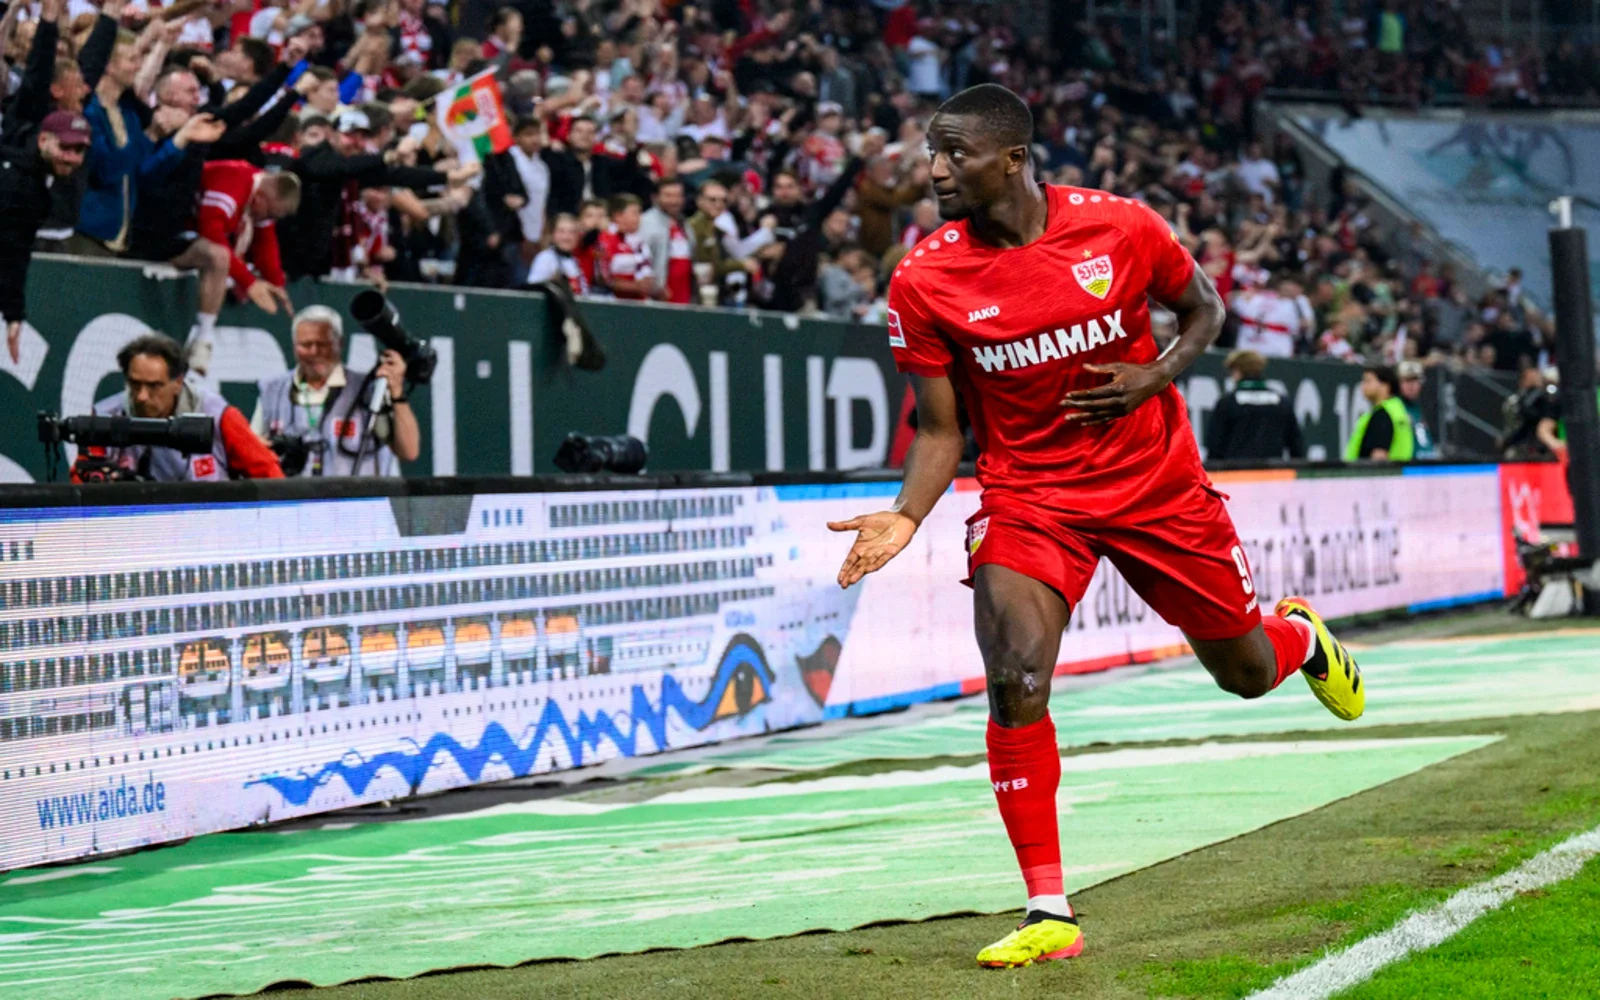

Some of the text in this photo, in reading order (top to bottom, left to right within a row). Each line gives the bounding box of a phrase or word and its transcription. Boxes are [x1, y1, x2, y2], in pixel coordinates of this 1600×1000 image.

[967, 305, 1000, 323] JAKO
[971, 309, 1128, 373] WINAMAX
[1230, 545, 1253, 595] 9
[36, 769, 166, 830] www.aida.de
[993, 777, 1029, 793] VfB
